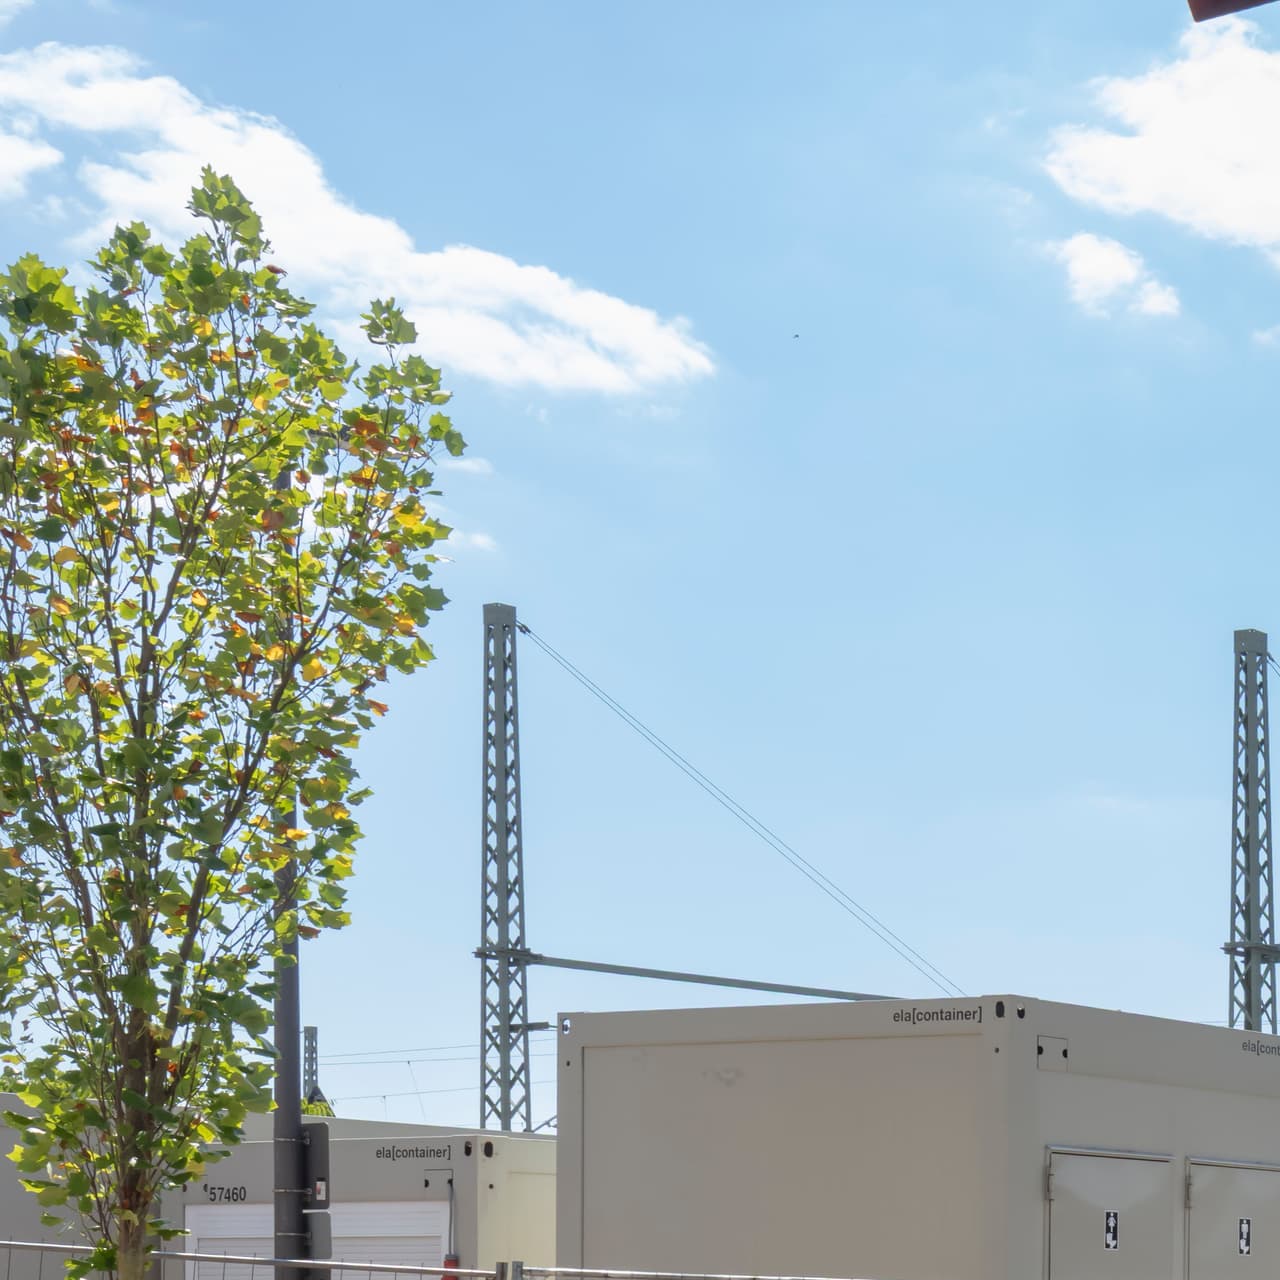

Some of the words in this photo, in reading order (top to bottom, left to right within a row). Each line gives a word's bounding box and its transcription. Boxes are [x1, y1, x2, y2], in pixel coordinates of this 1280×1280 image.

[893, 1006, 983, 1025] ela[container]
[375, 1145, 452, 1161] ela[container]
[208, 1186, 247, 1202] 57460
